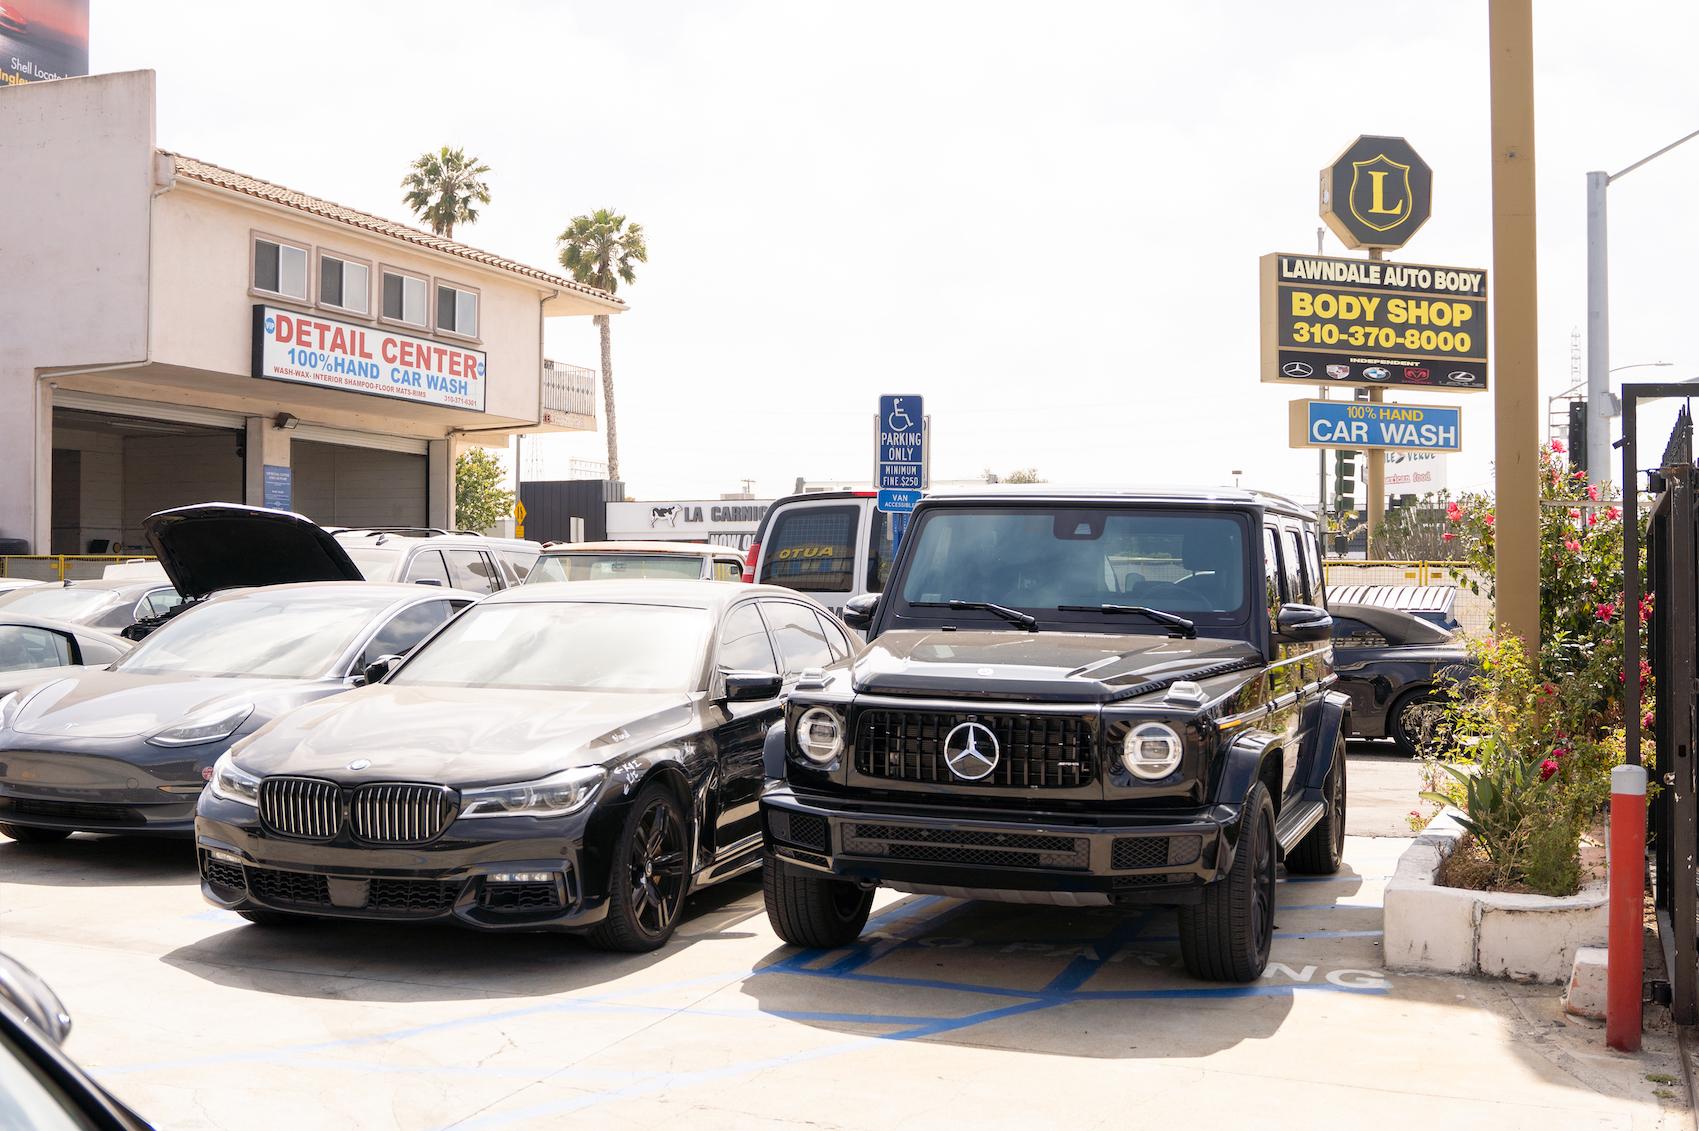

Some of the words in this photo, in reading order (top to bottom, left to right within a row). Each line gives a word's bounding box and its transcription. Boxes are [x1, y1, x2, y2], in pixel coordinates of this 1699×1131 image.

[11, 57, 32, 74] Shell
[1367, 171, 1403, 215] L
[1282, 258, 1381, 285] LAWNDALE
[1384, 266, 1431, 289] AUTO
[1435, 270, 1482, 292] BODY
[1291, 291, 1381, 321] BODY
[1387, 298, 1473, 327] SHOP
[275, 314, 373, 360] DETAIL
[381, 337, 478, 380] CENTER
[1292, 321, 1472, 353] 310-370-8000
[1349, 357, 1421, 367] INDEPENDENT
[313, 373, 343, 385] INTERIOR
[396, 387, 427, 398] MATS-RIMS
[390, 367, 421, 388] CAR
[426, 374, 468, 396] WASH
[1346, 406, 1377, 420] 100%
[1379, 408, 1424, 421] HAND
[881, 432, 921, 446] PARKING
[1312, 419, 1369, 443] CAR
[1379, 422, 1455, 447] WASH
[888, 447, 914, 461] ONLY
[885, 465, 917, 475] MINIMUM
[882, 476, 899, 486] FINE
[901, 476, 919, 486] $250
[892, 494, 908, 502] VAN
[684, 506, 704, 522] LA
[1000, 941, 1395, 989] PARNG
